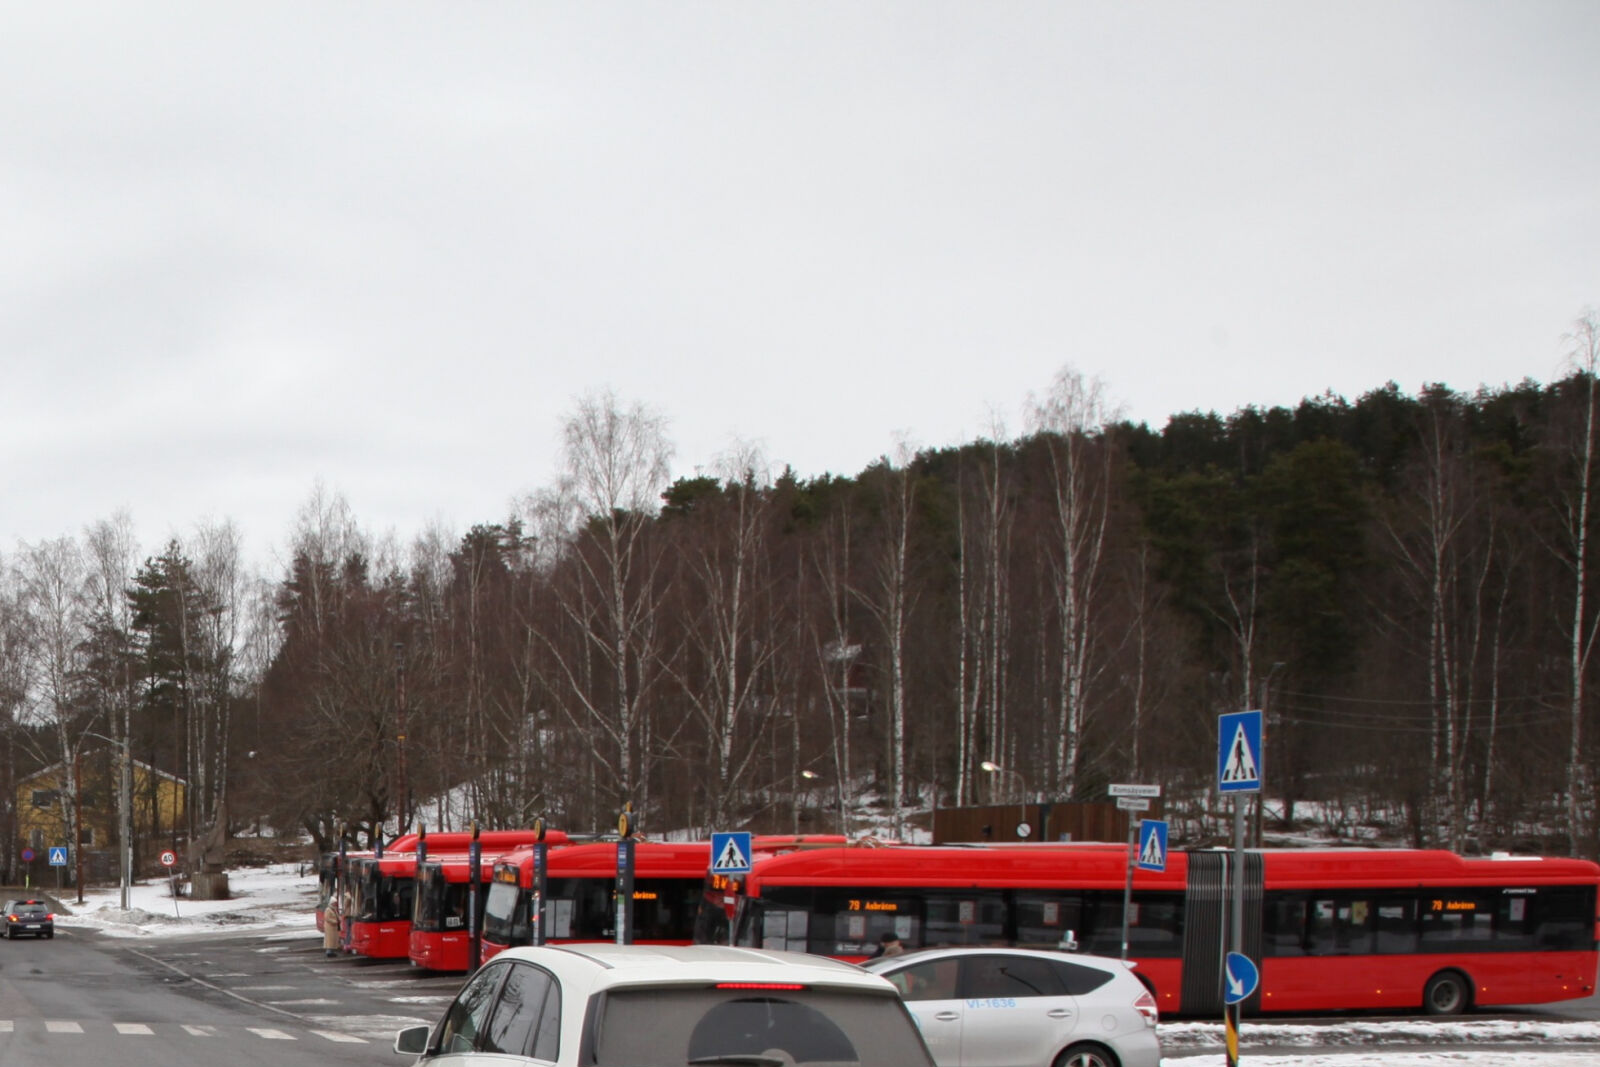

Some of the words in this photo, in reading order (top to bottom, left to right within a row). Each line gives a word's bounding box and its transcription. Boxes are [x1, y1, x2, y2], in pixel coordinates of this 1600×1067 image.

[163, 854, 173, 863] 40
[848, 899, 861, 911] 79
[966, 999, 1016, 1009] VI-1636
